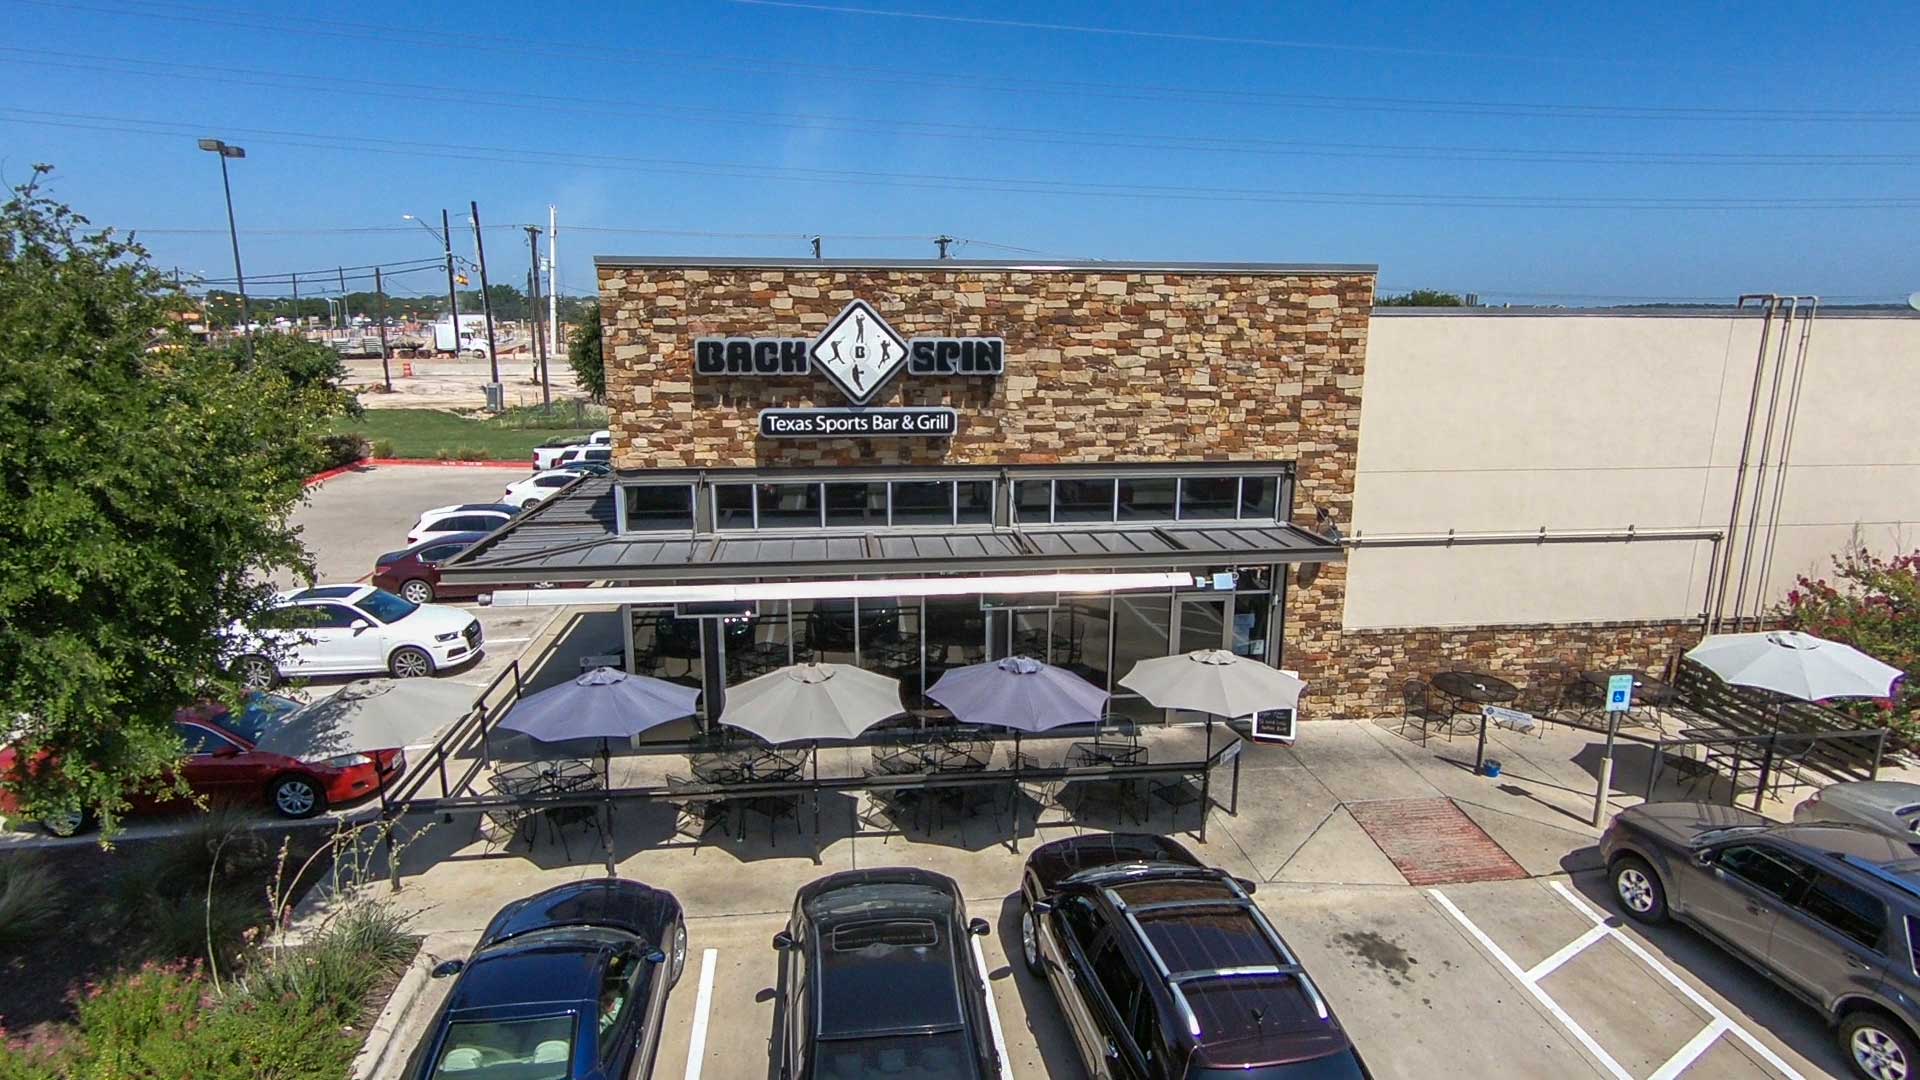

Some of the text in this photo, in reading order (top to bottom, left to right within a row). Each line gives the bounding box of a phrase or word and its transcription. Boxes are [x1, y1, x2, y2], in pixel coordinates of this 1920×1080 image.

[697, 340, 1002, 373] BACK SPIN
[855, 346, 865, 358] B
[766, 413, 949, 433] Texas Sports Bar & Grill
